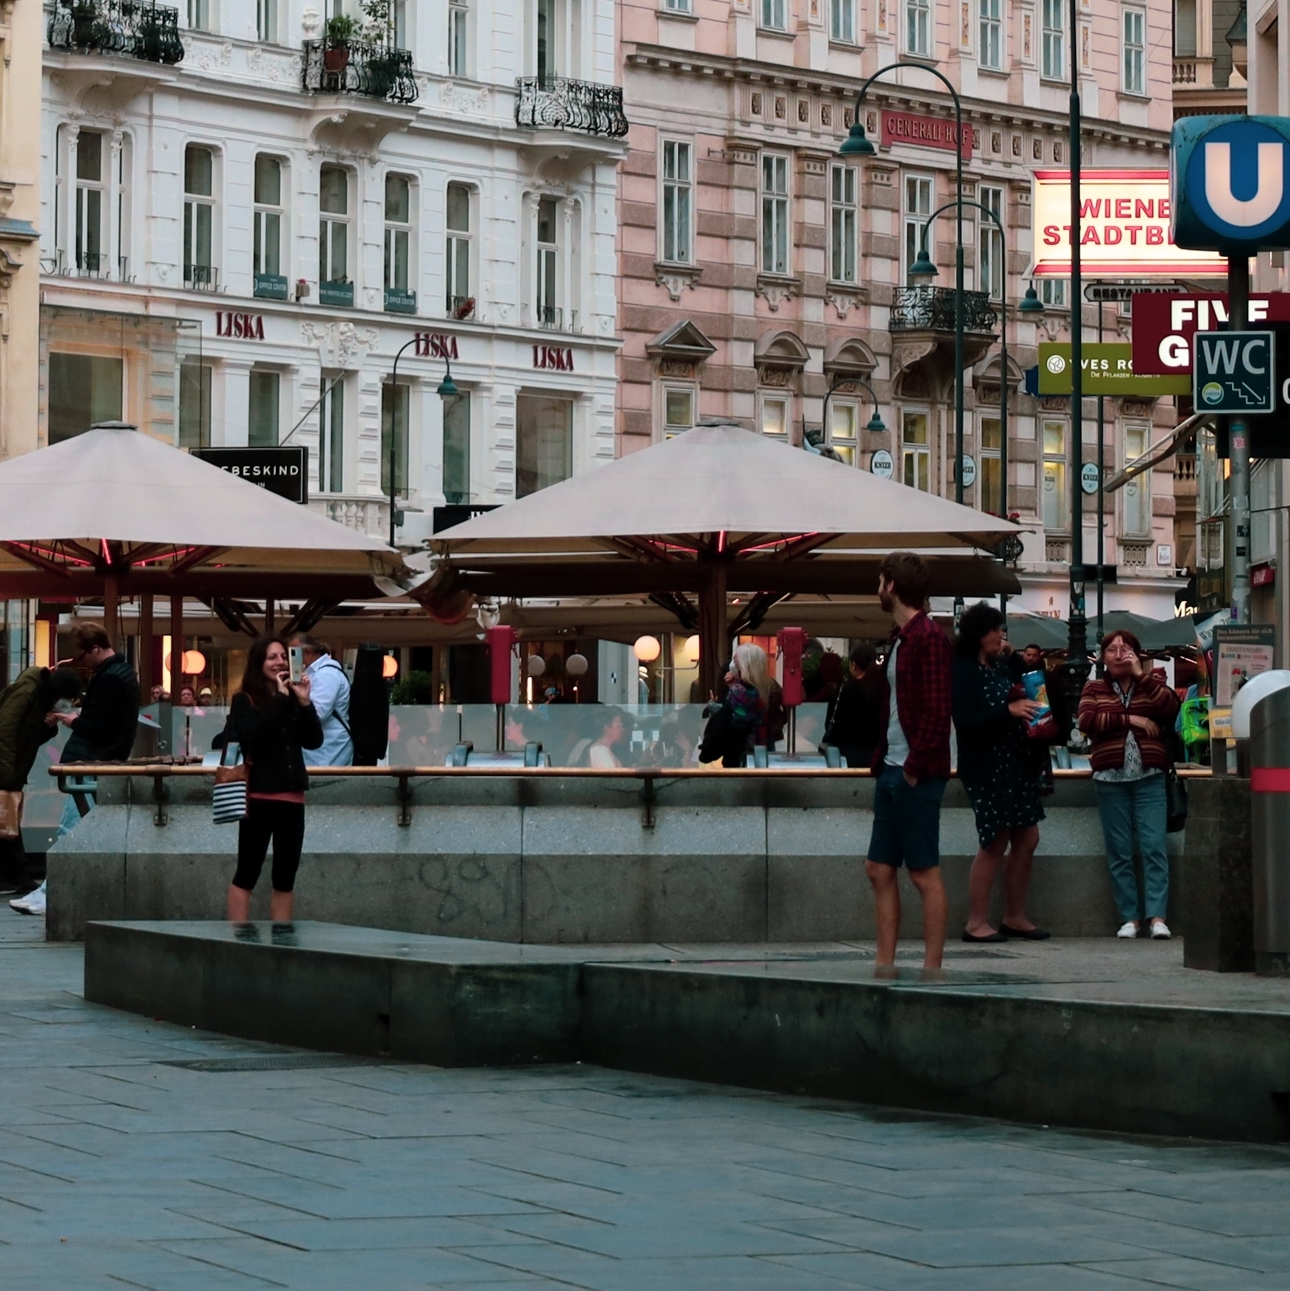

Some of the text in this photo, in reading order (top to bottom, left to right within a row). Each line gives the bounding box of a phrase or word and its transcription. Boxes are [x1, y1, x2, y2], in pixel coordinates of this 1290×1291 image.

[1205, 142, 1284, 227] U
[1080, 198, 1170, 219] WIENE
[216, 311, 265, 340] LISKA
[415, 332, 460, 360] LISKA
[532, 345, 575, 372] LISKA
[1159, 335, 1190, 367] G
[1201, 339, 1266, 375] WC
[1069, 359, 1109, 370] VES
